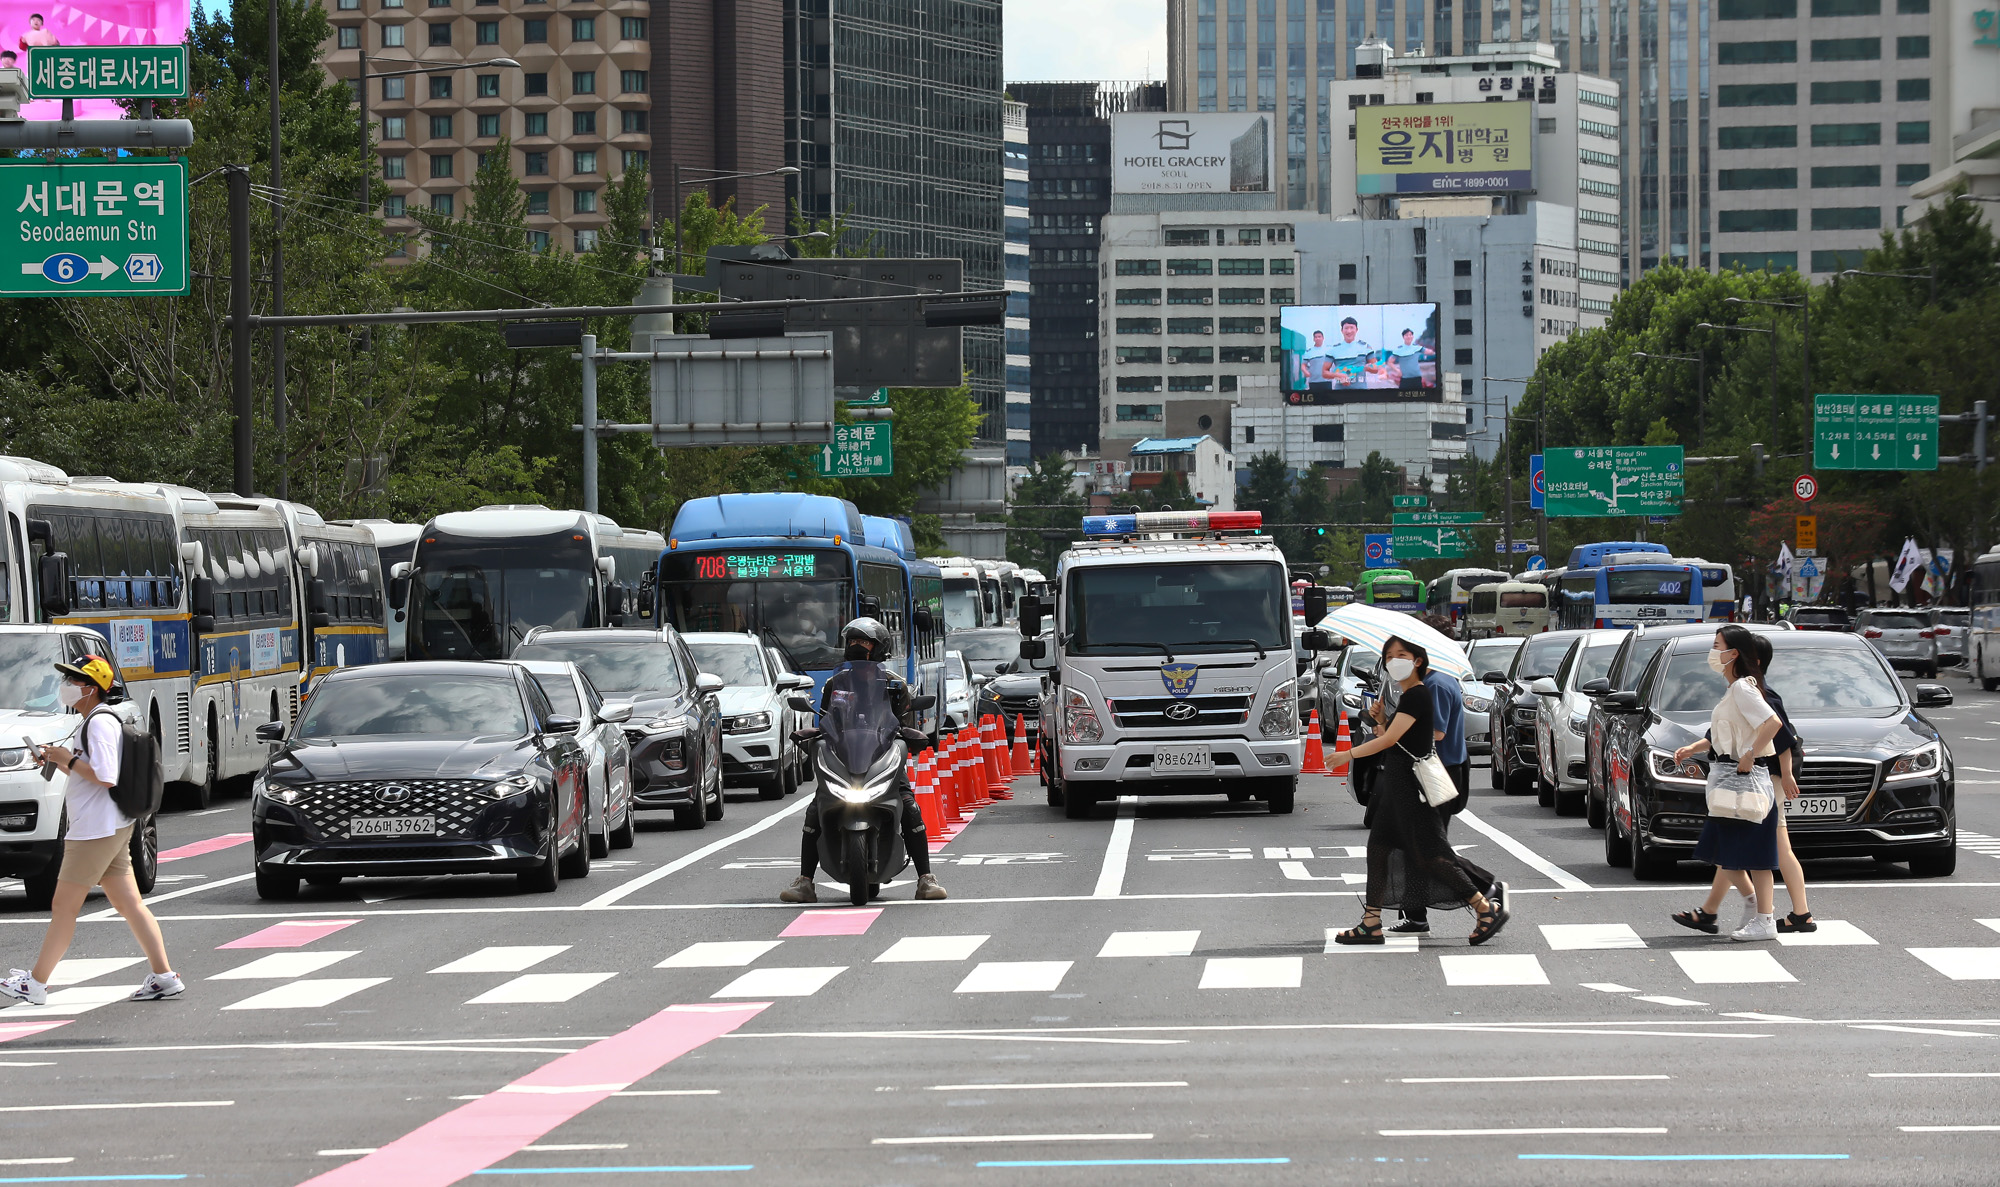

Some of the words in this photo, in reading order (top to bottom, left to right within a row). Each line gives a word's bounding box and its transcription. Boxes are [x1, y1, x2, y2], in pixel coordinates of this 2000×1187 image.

[35, 56, 179, 90] 세종대로사거리
[1381, 117, 1402, 130] 전국
[1403, 115, 1432, 129] 취업률
[1435, 115, 1454, 128] 1위!
[1457, 128, 1509, 145] 대학교
[1378, 130, 1454, 165] 을지
[1124, 156, 1165, 167] HOTEL
[1168, 156, 1226, 167] GRACERY
[1161, 170, 1188, 178] SEOUL
[1186, 182, 1212, 190] OPEN
[16, 179, 165, 217] 서대문역
[20, 220, 120, 242] Seodaemun
[127, 219, 157, 241] Stn
[57, 258, 74, 280] 6
[131, 259, 155, 276] 21
[1860, 403, 1894, 416] 숭례문
[1898, 404, 1937, 416] 신촌로터리
[836, 426, 876, 441] 숭례문
[837, 452, 863, 467] 시청
[1587, 449, 1613, 458] 서울역
[837, 467, 853, 475] City
[1587, 460, 1613, 470] 숭례문
[1798, 481, 1813, 495] 50
[696, 556, 726, 579] 708
[737, 566, 769, 578] 불광역
[782, 565, 815, 577] 서울역
[1659, 581, 1681, 594] 402
[161, 632, 177, 660] POLICE
[281, 635, 293, 658] POLICE
[1800, 799, 1838, 813] 9590
